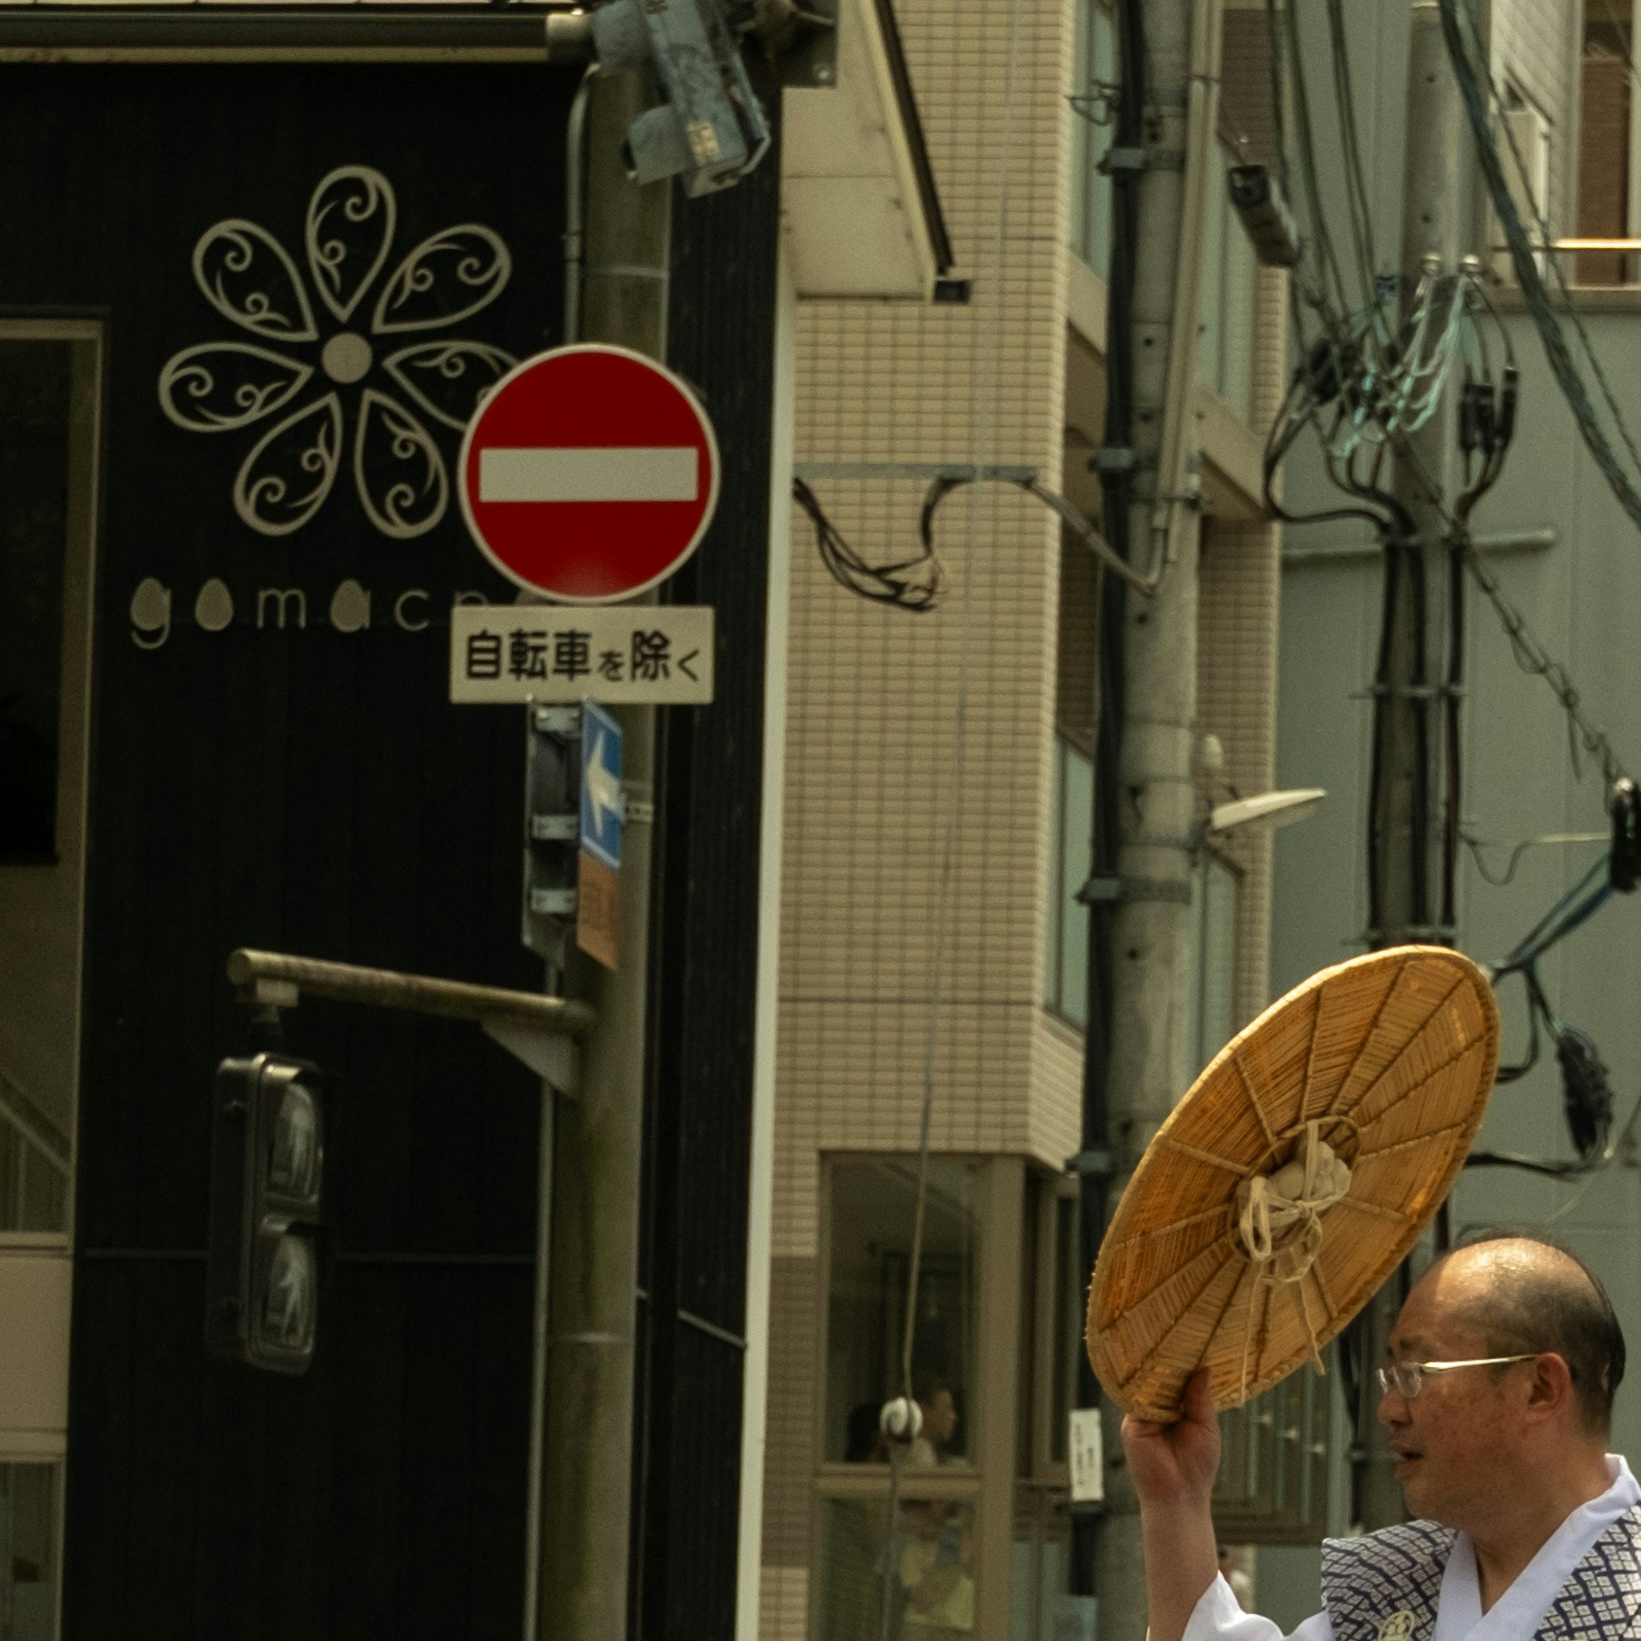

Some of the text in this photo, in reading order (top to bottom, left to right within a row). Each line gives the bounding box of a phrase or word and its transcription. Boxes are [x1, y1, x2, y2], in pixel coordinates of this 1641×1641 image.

[129, 577, 556, 650] gomac
[465, 629, 700, 681] 自転車を除く
